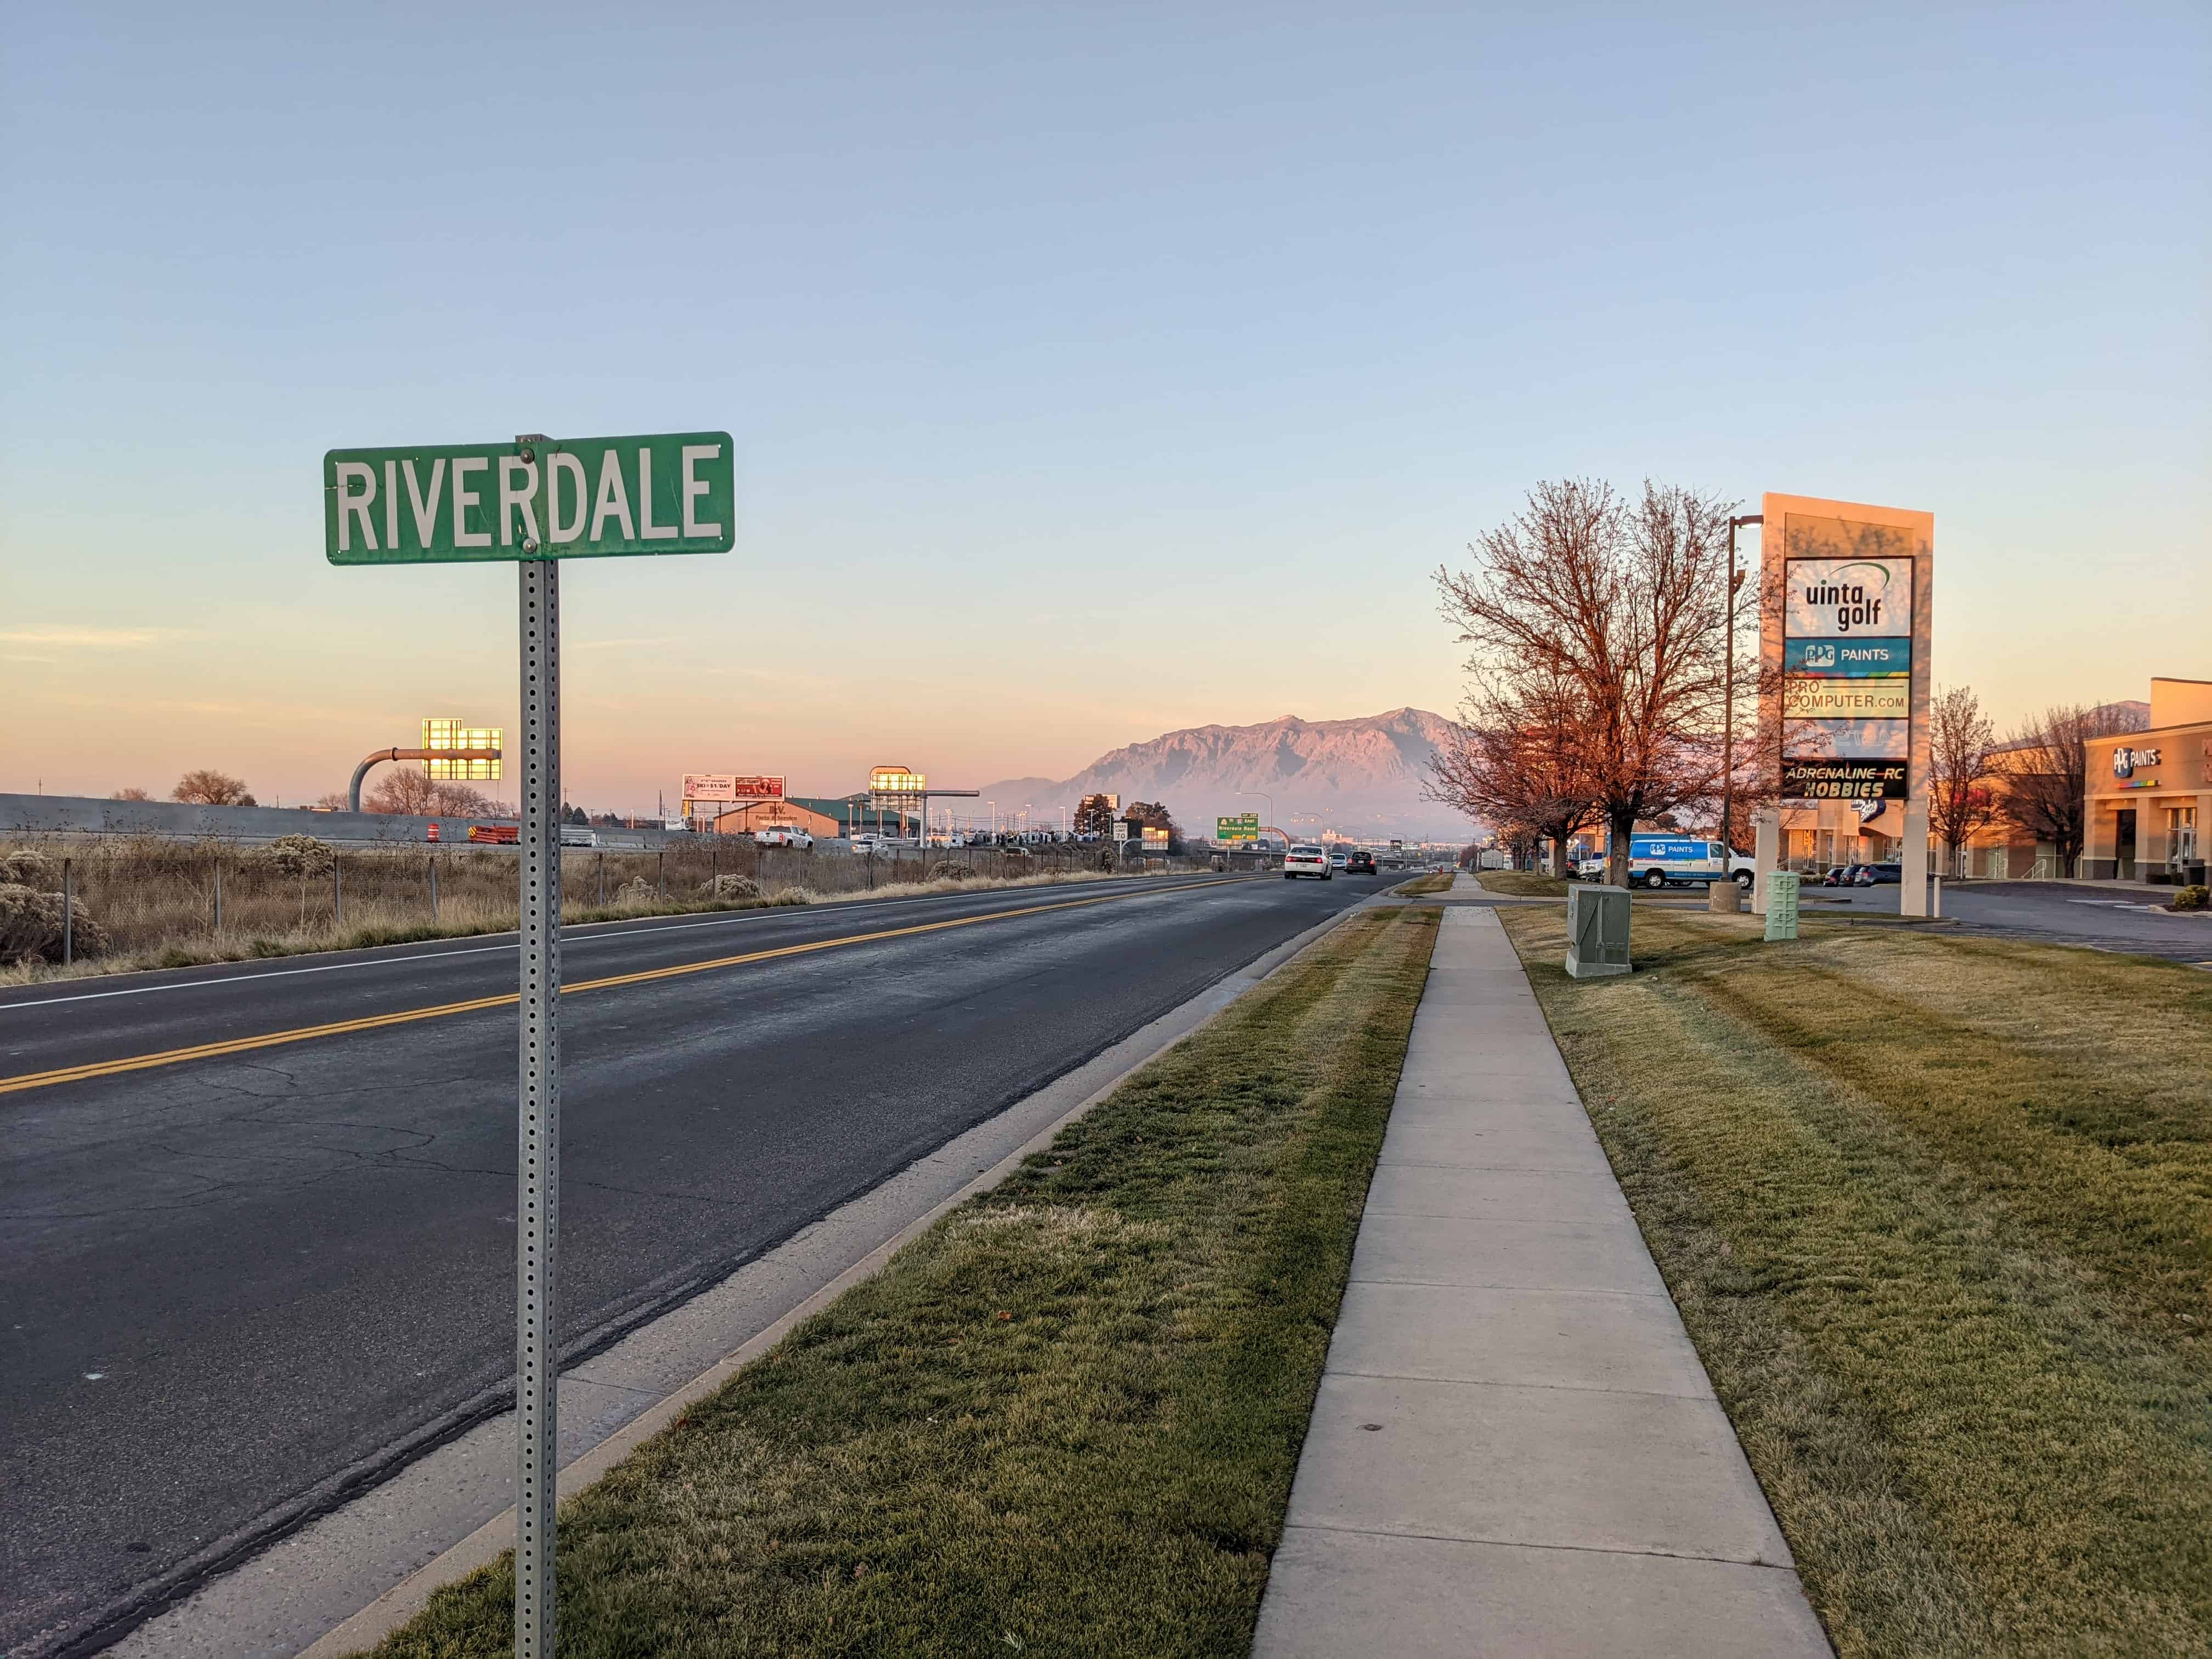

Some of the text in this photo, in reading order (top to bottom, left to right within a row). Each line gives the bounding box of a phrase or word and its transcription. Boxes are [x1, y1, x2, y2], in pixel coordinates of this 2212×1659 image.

[336, 444, 722, 550] RIVERDALE
[1806, 579, 1863, 605] uinta
[1837, 599, 1881, 631] golf
[1806, 645, 1889, 664] PPG PAINTS
[1789, 681, 1820, 693] PRO
[1788, 695, 1904, 708] COMPUTER.COM
[2114, 748, 2156, 773] PPG PAINTS
[1804, 782, 1884, 797] HOBBIES
[1650, 844, 1666, 854] PPG
